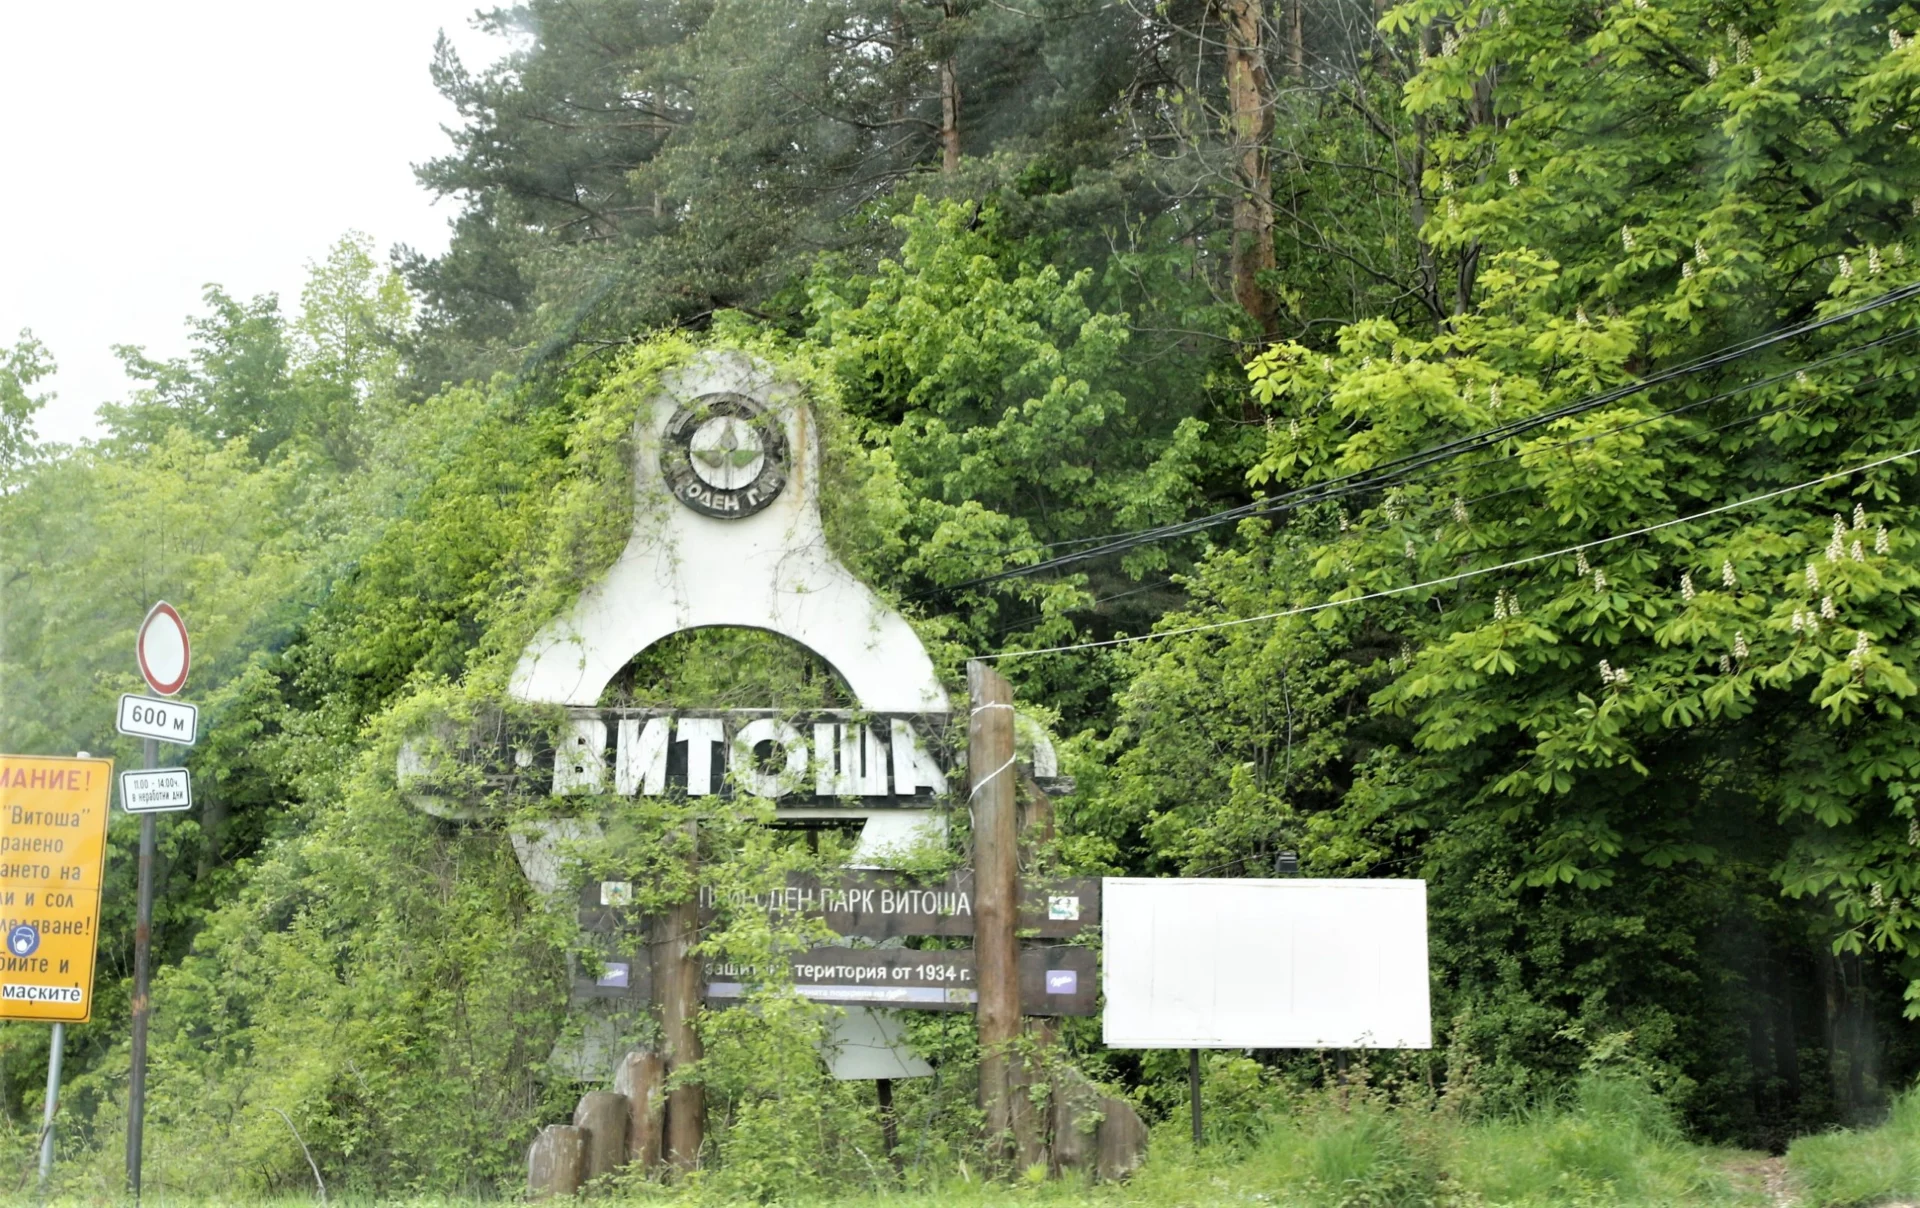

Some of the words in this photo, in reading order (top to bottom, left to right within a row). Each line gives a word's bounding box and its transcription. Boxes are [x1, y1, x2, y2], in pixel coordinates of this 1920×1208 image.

[132, 705, 167, 728] 600
[552, 716, 950, 799] ВИТОША
[138, 789, 170, 805] неработни
[172, 790, 184, 801] дни
[0, 835, 65, 856] ранено
[60, 865, 81, 881] на
[25, 892, 35, 907] и
[45, 892, 74, 908] сол
[820, 888, 875, 914] ПАРК
[881, 889, 972, 917] ВИТОША
[59, 958, 70, 975] и
[794, 963, 887, 983] територия
[892, 966, 912, 981] от
[916, 964, 957, 981] 1934
[960, 967, 971, 982] г.
[2, 984, 81, 1002] маските
